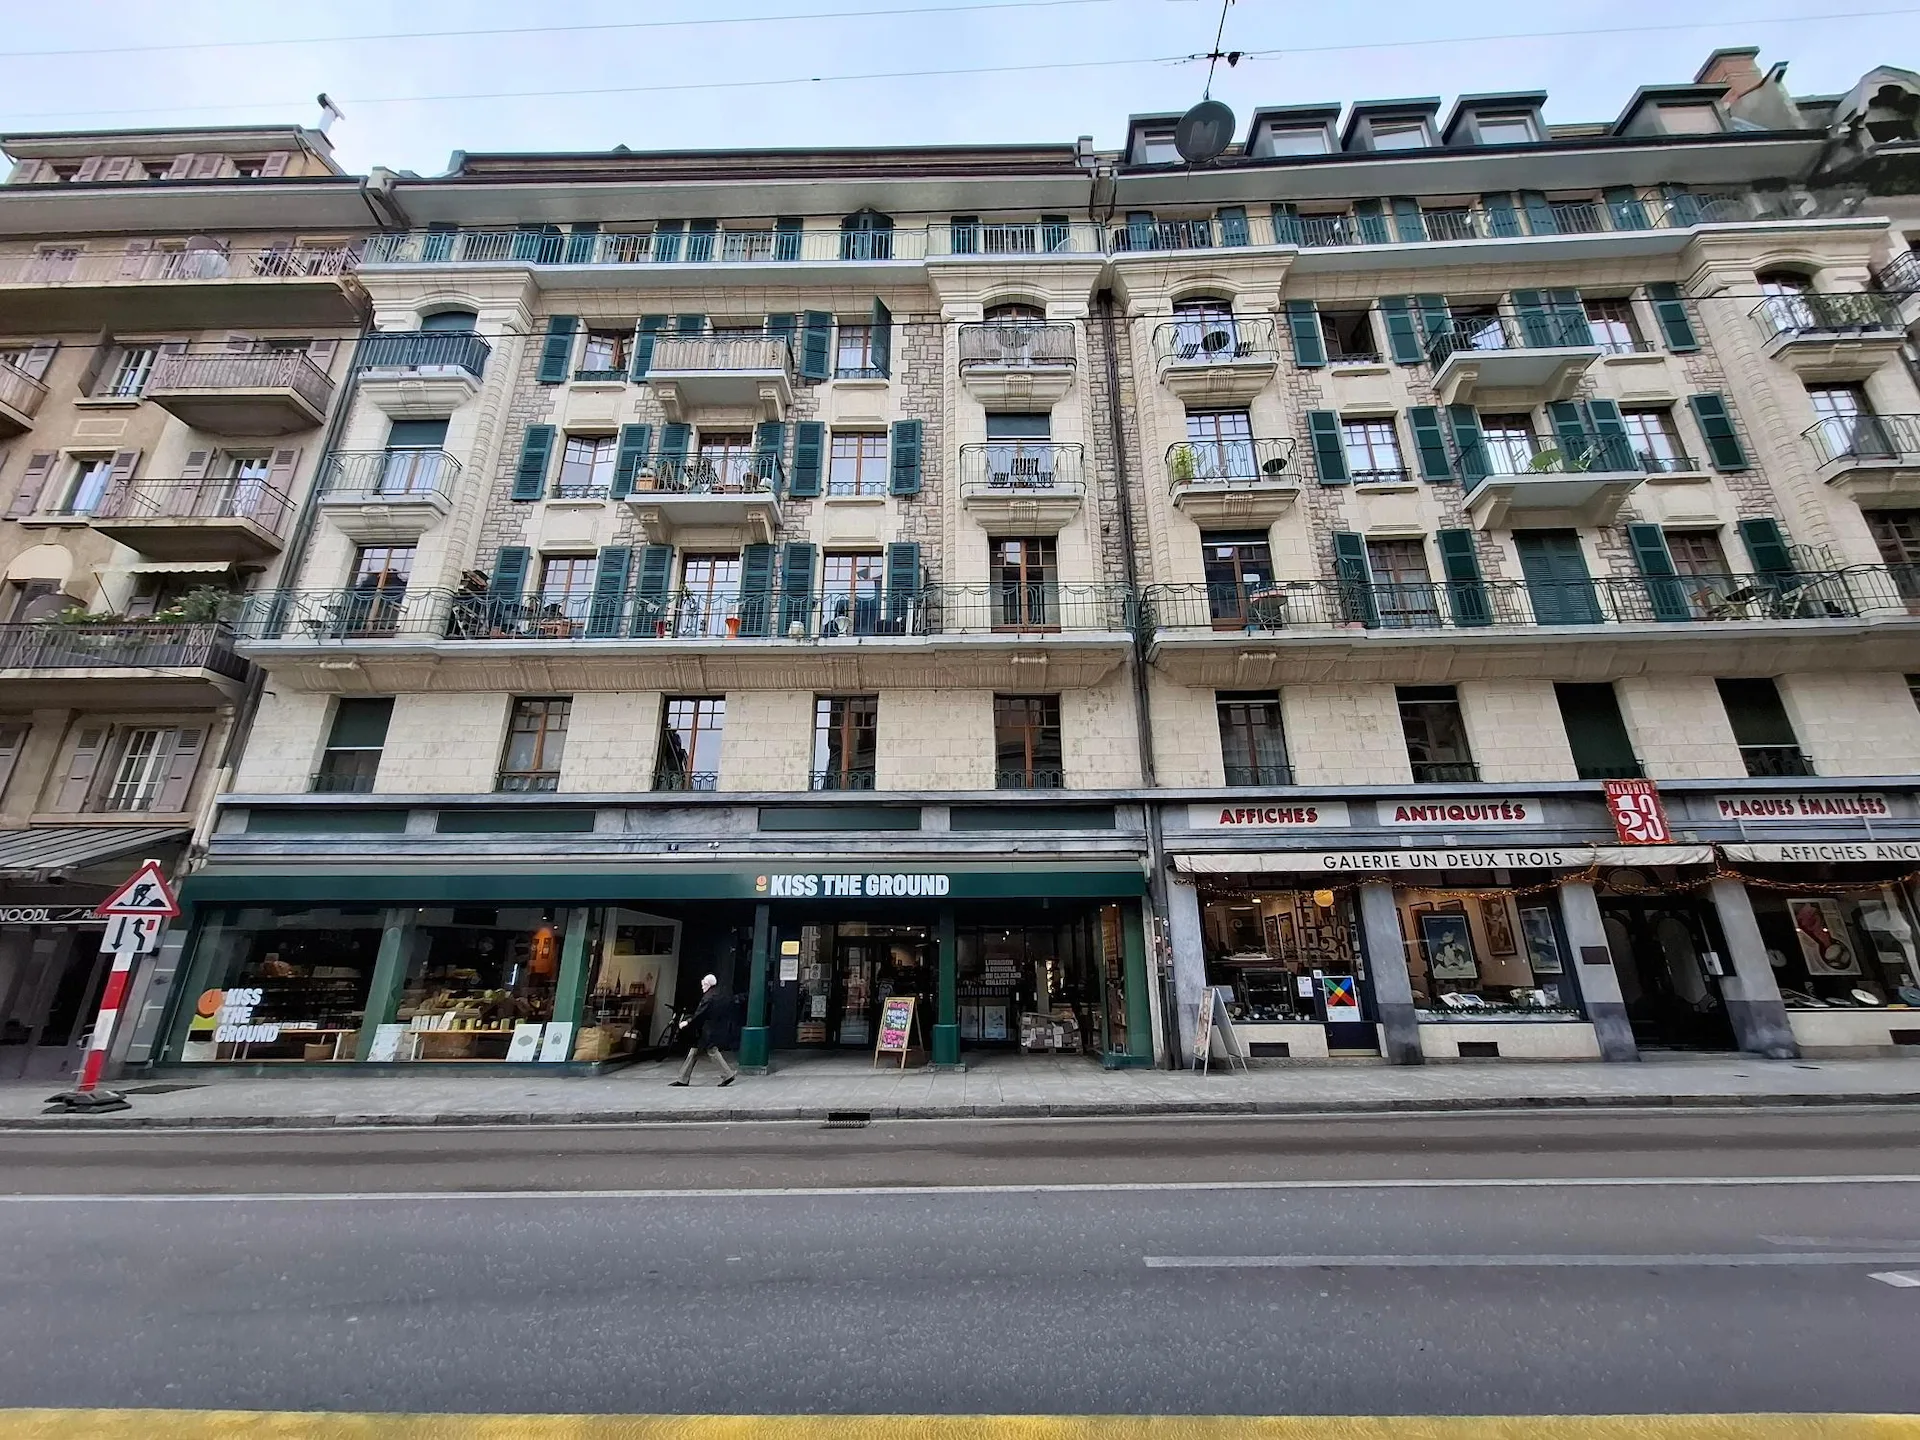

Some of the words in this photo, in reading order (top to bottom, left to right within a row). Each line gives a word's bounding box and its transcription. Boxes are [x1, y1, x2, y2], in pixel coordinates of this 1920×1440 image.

[1608, 782, 1651, 795] GALERIE
[1395, 800, 1526, 822] ANTIQUITÉS
[1718, 799, 1795, 816] PLAQUES
[1797, 793, 1888, 816] ÉMAILLÉES
[1219, 807, 1318, 824] AFFICHES
[1323, 854, 1401, 869] GALERIE
[1409, 854, 1438, 868] UN
[1446, 853, 1499, 867] DEUX
[1505, 852, 1563, 866] TROIS
[1780, 846, 1867, 861] AFFICHES
[770, 875, 819, 896] KISS
[822, 875, 862, 896] THE
[865, 874, 950, 896] GROUND
[225, 988, 263, 1006] KISS
[221, 1006, 254, 1024] THE
[215, 1025, 280, 1042] GROUND
